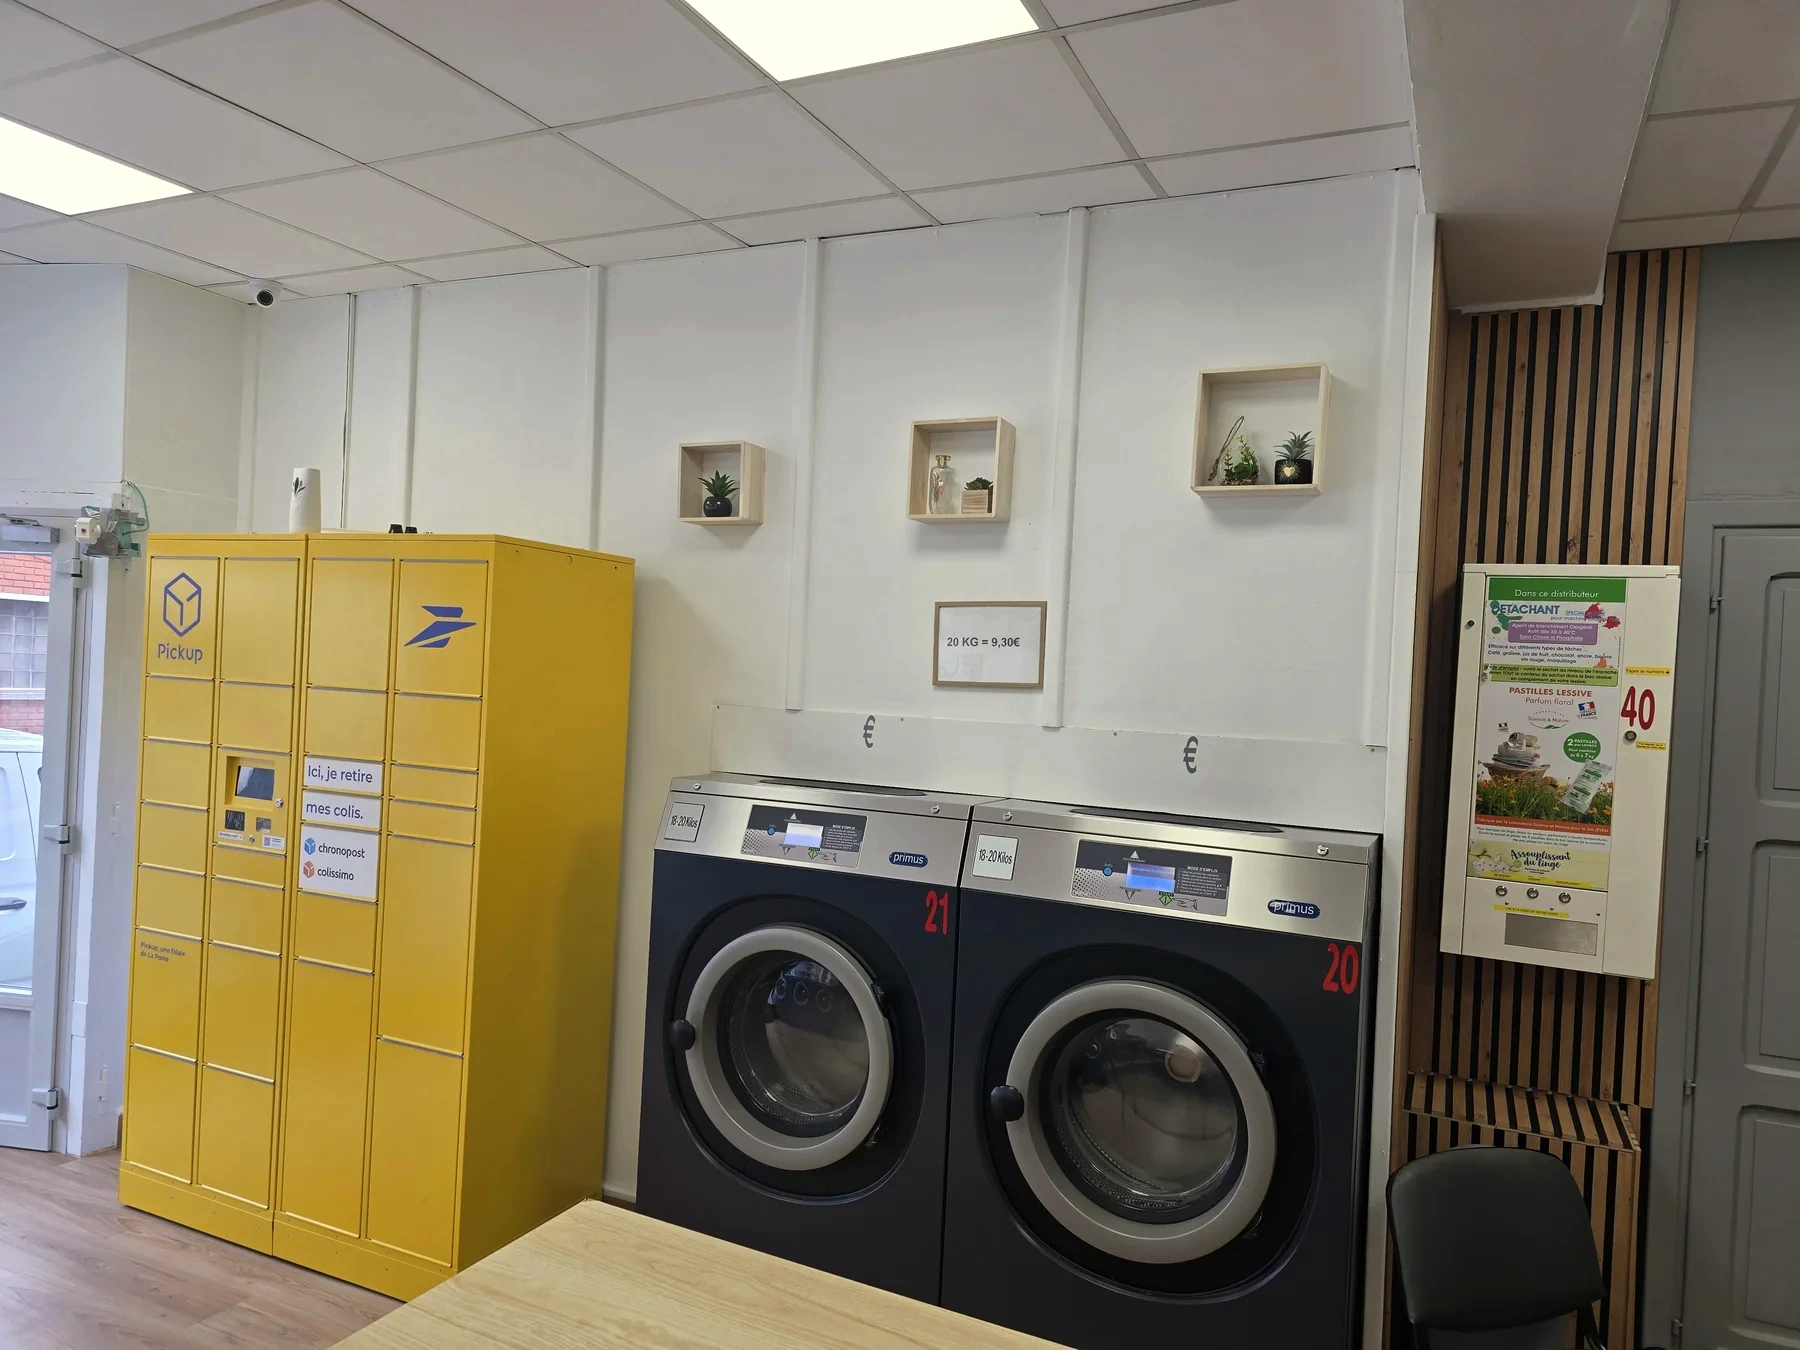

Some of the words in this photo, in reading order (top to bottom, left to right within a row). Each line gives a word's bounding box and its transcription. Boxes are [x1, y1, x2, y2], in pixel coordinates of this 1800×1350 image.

[1551, 590, 1600, 598] distributeur
[947, 637, 959, 647] 20
[962, 637, 979, 647] KG
[992, 637, 1020, 648] 9,30€
[157, 643, 203, 665] Pickup
[1509, 687, 1554, 695] PASTILLES
[1557, 688, 1593, 697] LESSIVE
[1526, 697, 1552, 706] Parfum
[1554, 698, 1574, 706] floral
[1621, 686, 1656, 731] 40
[862, 715, 876, 749] €
[1182, 735, 1199, 774] €
[308, 765, 324, 782] Ici,
[326, 766, 338, 782] je
[340, 768, 373, 784] retire
[305, 803, 331, 815] mes
[334, 805, 364, 820] colis.
[671, 815, 687, 827] 18-20
[686, 815, 699, 829] Kilos
[318, 842, 366, 860] chronopost
[978, 848, 998, 863] 18-20
[998, 852, 1013, 866] Kilos
[1510, 849, 1572, 861] Assouplissant
[893, 852, 925, 867] primus
[1523, 859, 1536, 867] du
[1538, 859, 1561, 871] linge
[317, 866, 355, 881] colissimo
[924, 890, 949, 935] 21
[1273, 900, 1315, 917] primus
[140, 942, 160, 952] Pickup,
[171, 948, 186, 957] filiale
[155, 954, 169, 962] Poste
[1322, 942, 1360, 995] 20
